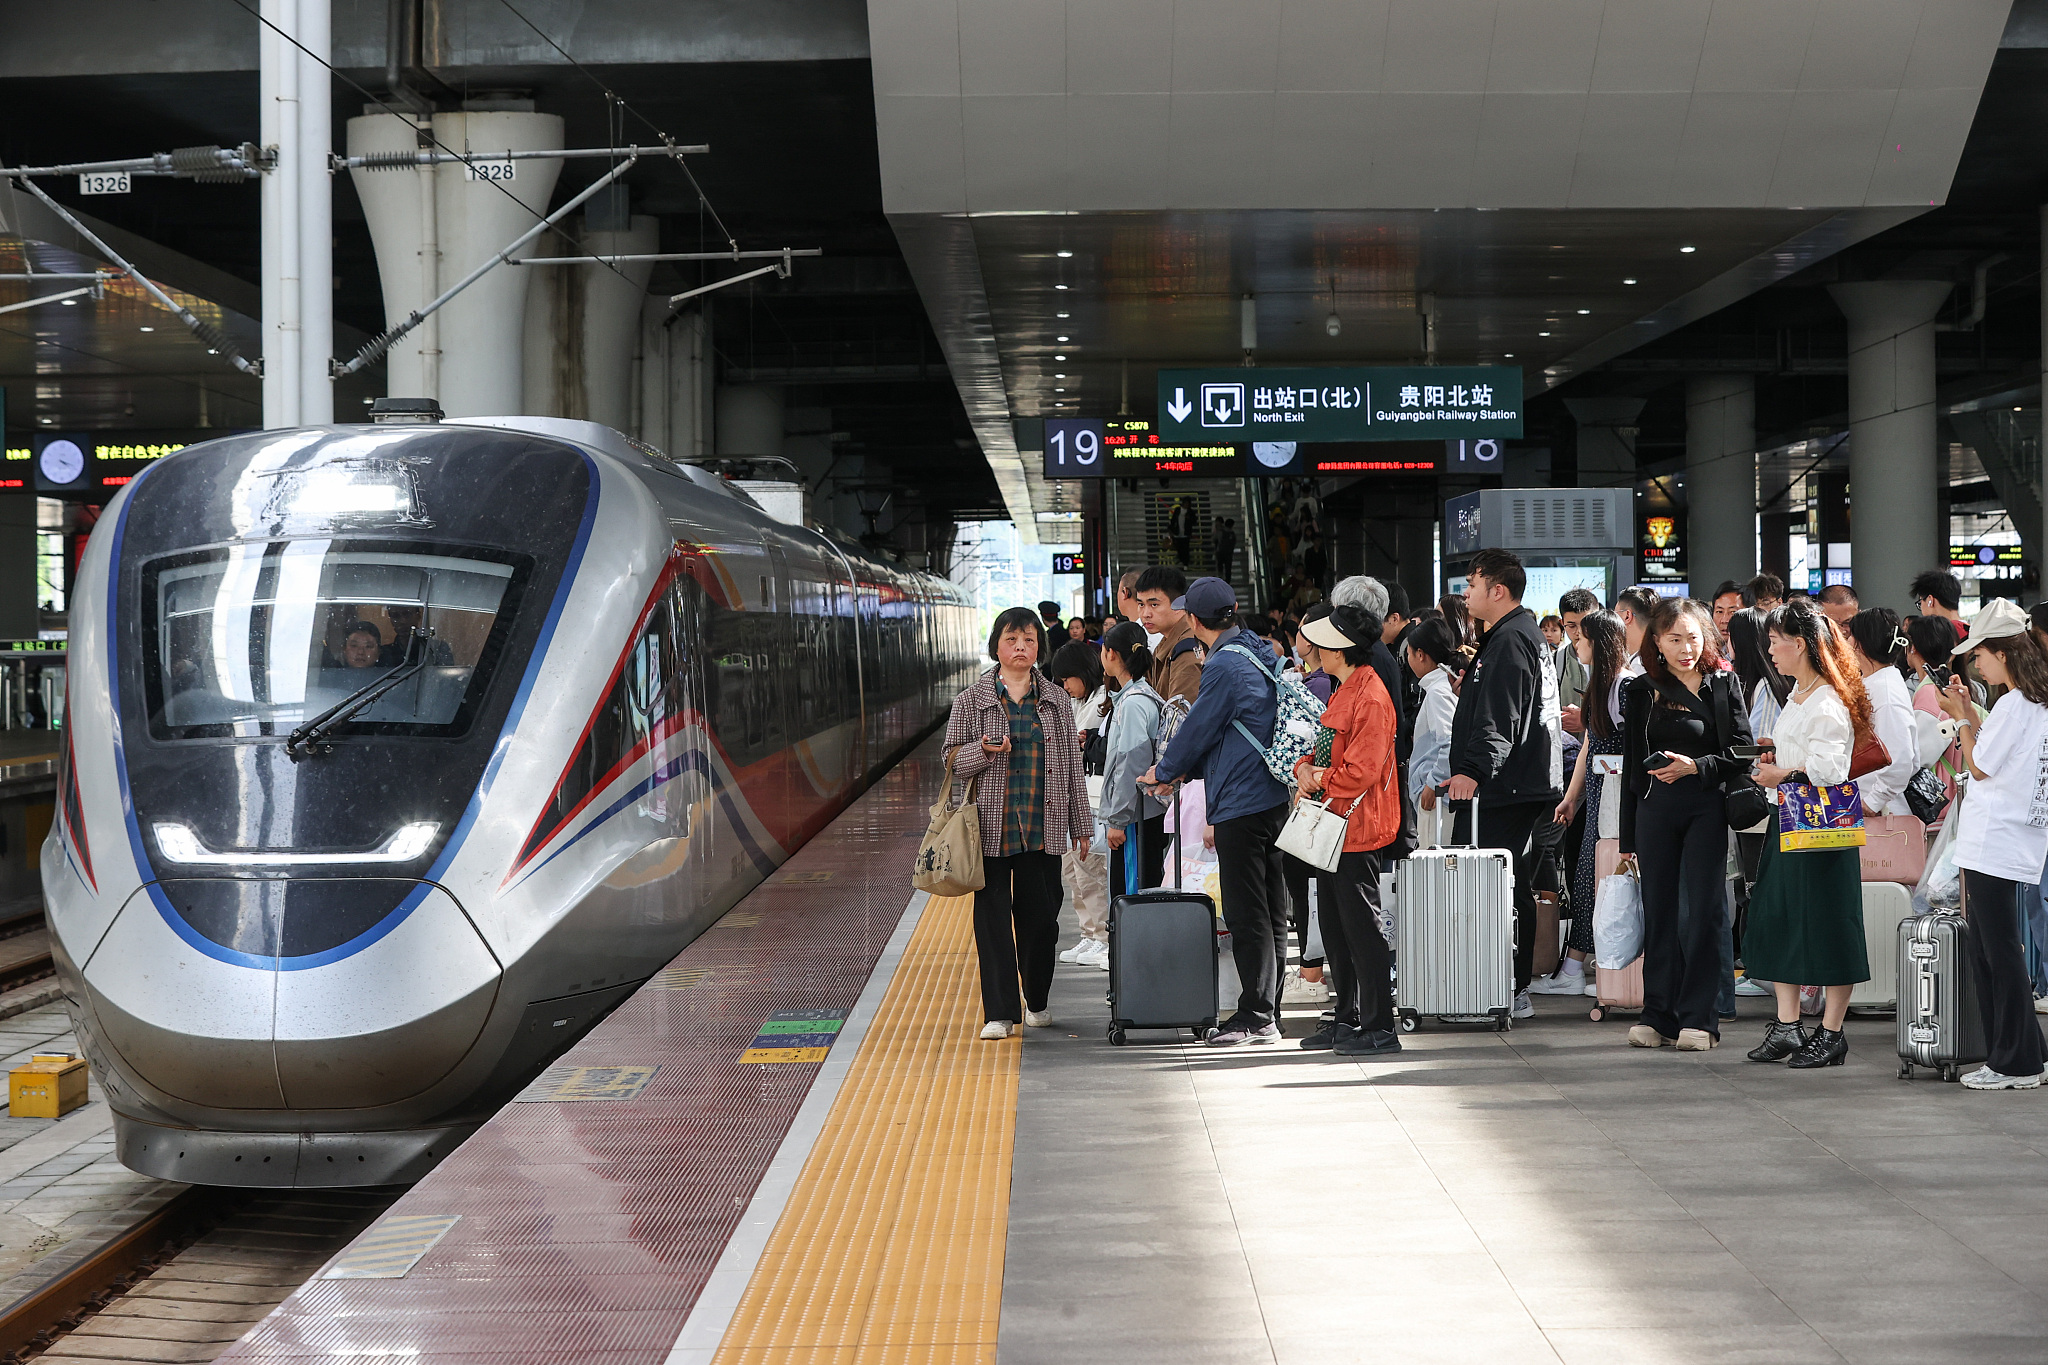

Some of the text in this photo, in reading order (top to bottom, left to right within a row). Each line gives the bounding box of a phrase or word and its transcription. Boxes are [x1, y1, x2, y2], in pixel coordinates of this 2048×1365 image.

[469, 164, 514, 181] 1328
[84, 176, 128, 192] 1326
[1253, 386, 1361, 410] 出站口(北)
[1399, 384, 1493, 408] 贵阳北站
[1253, 413, 1305, 423] North Exit
[1376, 410, 1517, 423] Guiyangbei Railway Station
[1123, 421, 1149, 431] C5878
[1050, 429, 1098, 465] 19
[1104, 435, 1127, 445] 16:26
[1129, 435, 1139, 444] 开
[1459, 439, 1498, 461] 18
[1054, 556, 1073, 571] 19
